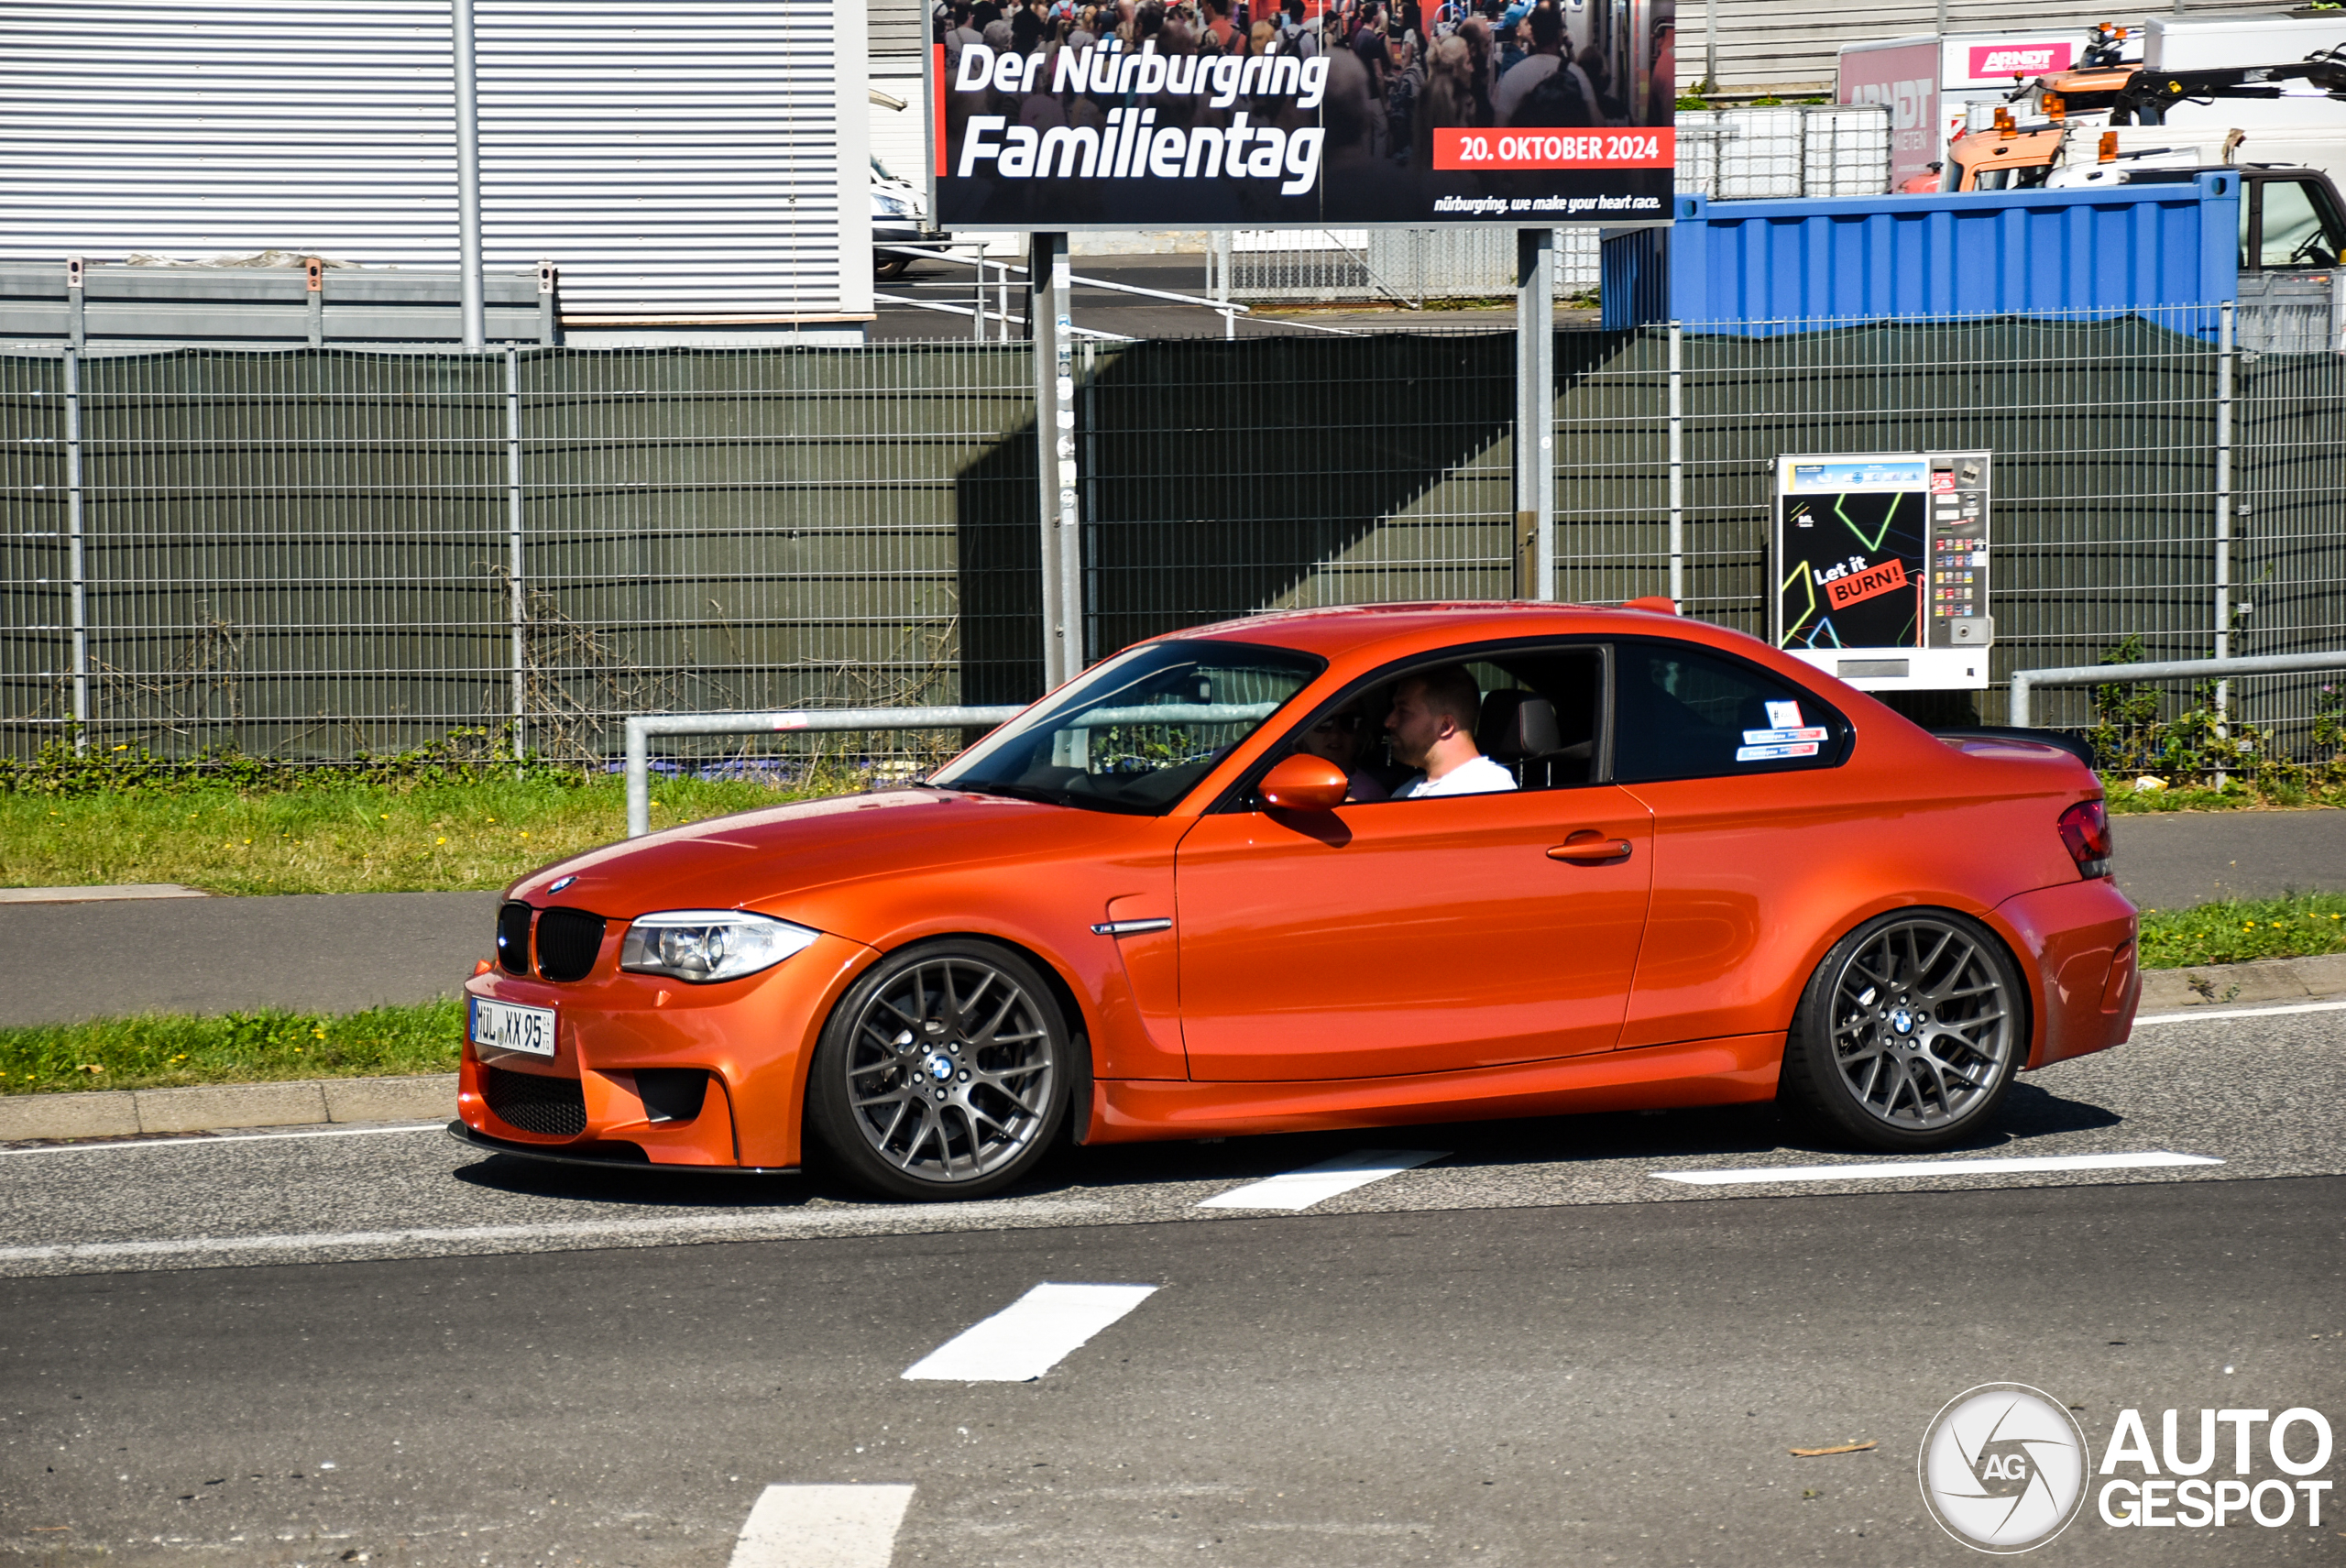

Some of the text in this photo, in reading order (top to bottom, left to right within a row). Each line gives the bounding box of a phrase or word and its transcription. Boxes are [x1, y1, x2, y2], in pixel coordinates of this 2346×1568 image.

[954, 38, 1331, 108] Der Nürburgring
[1981, 49, 2055, 72] ARNDT
[958, 107, 1326, 196] Familientag
[1459, 136, 1660, 160] 20. OKTOBER 2024
[1433, 194, 1661, 214] nürburgring. we make your heart race.
[1813, 555, 1869, 586] Let it
[1834, 565, 1901, 602] BURN!
[504, 1009, 522, 1047] XX
[524, 1014, 542, 1048] 95
